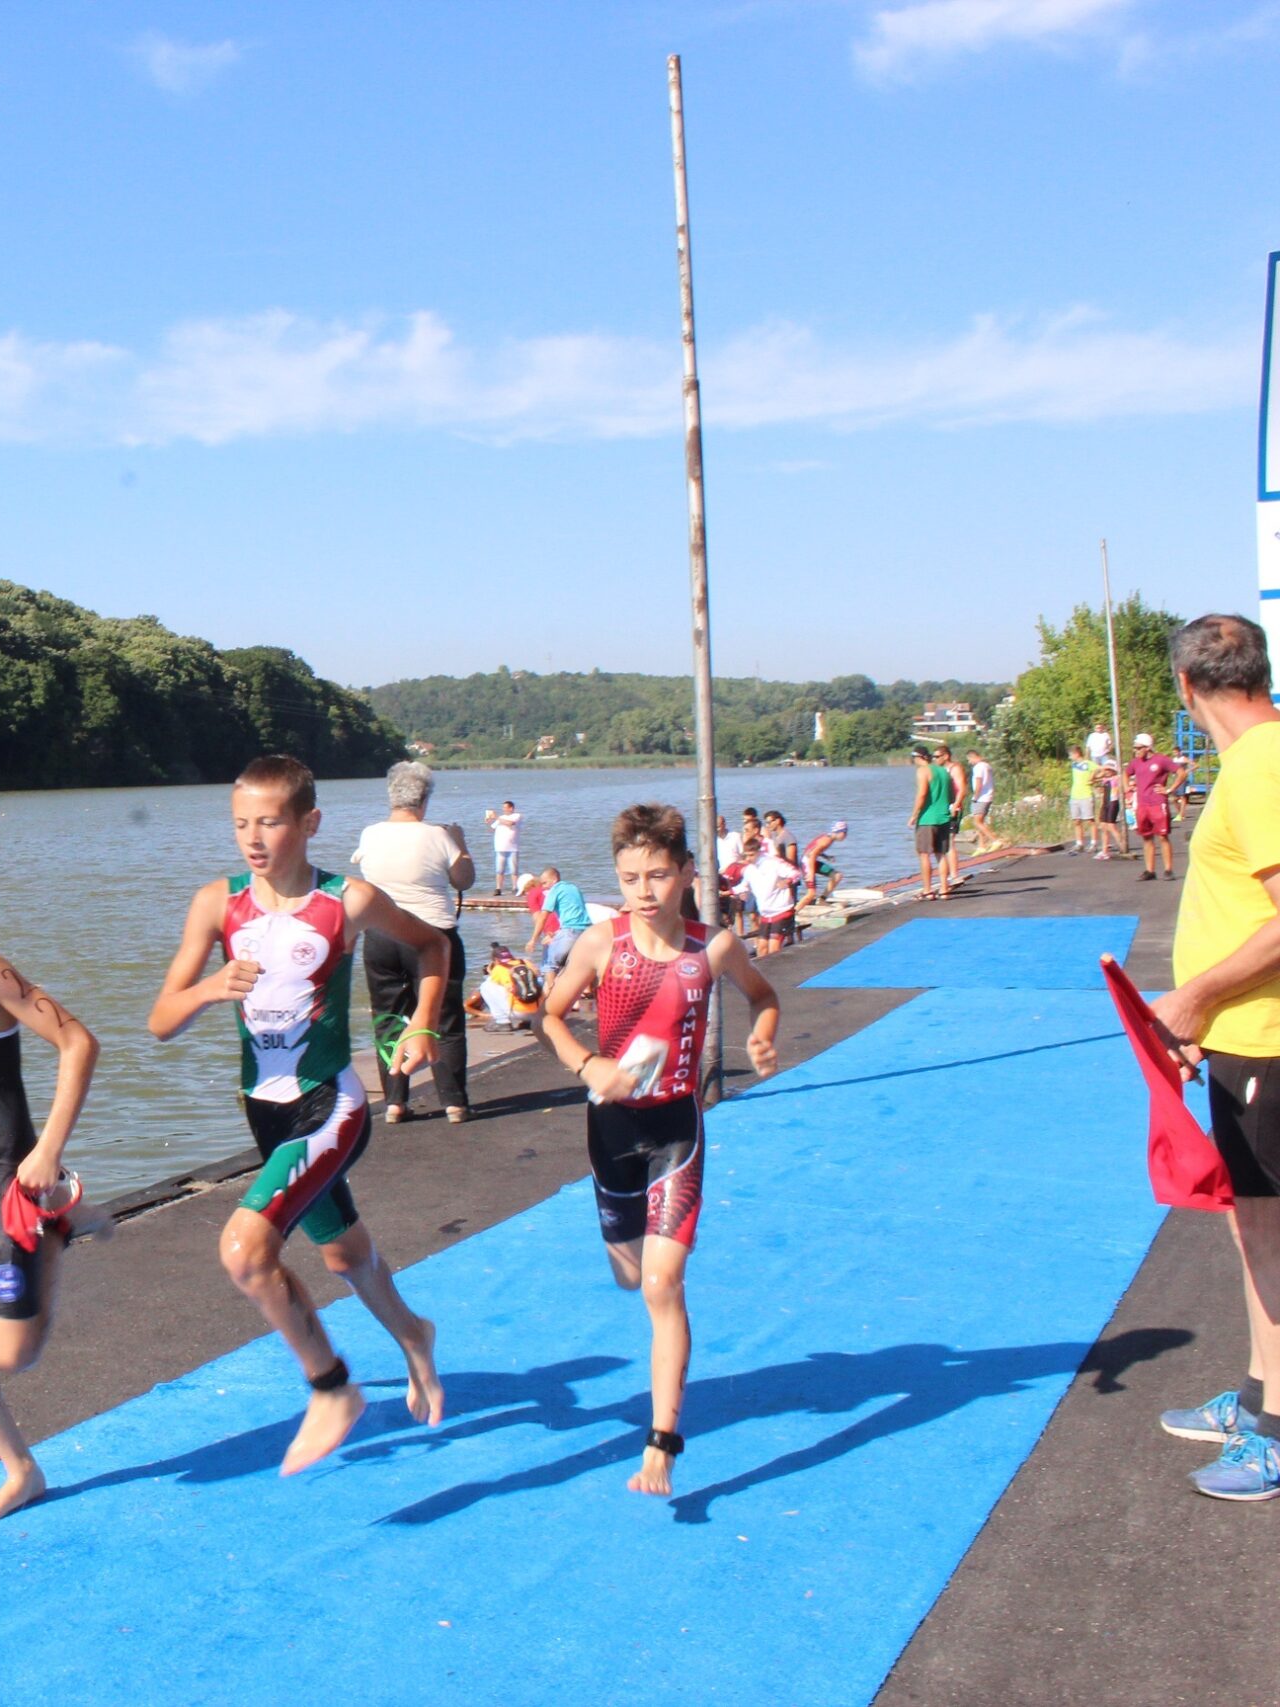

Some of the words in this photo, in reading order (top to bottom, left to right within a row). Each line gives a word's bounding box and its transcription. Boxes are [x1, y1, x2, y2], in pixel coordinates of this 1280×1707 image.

[1, 969, 78, 1028] 22
[262, 1033, 289, 1050] BUL
[672, 988, 702, 1094] ШАМПИОН
